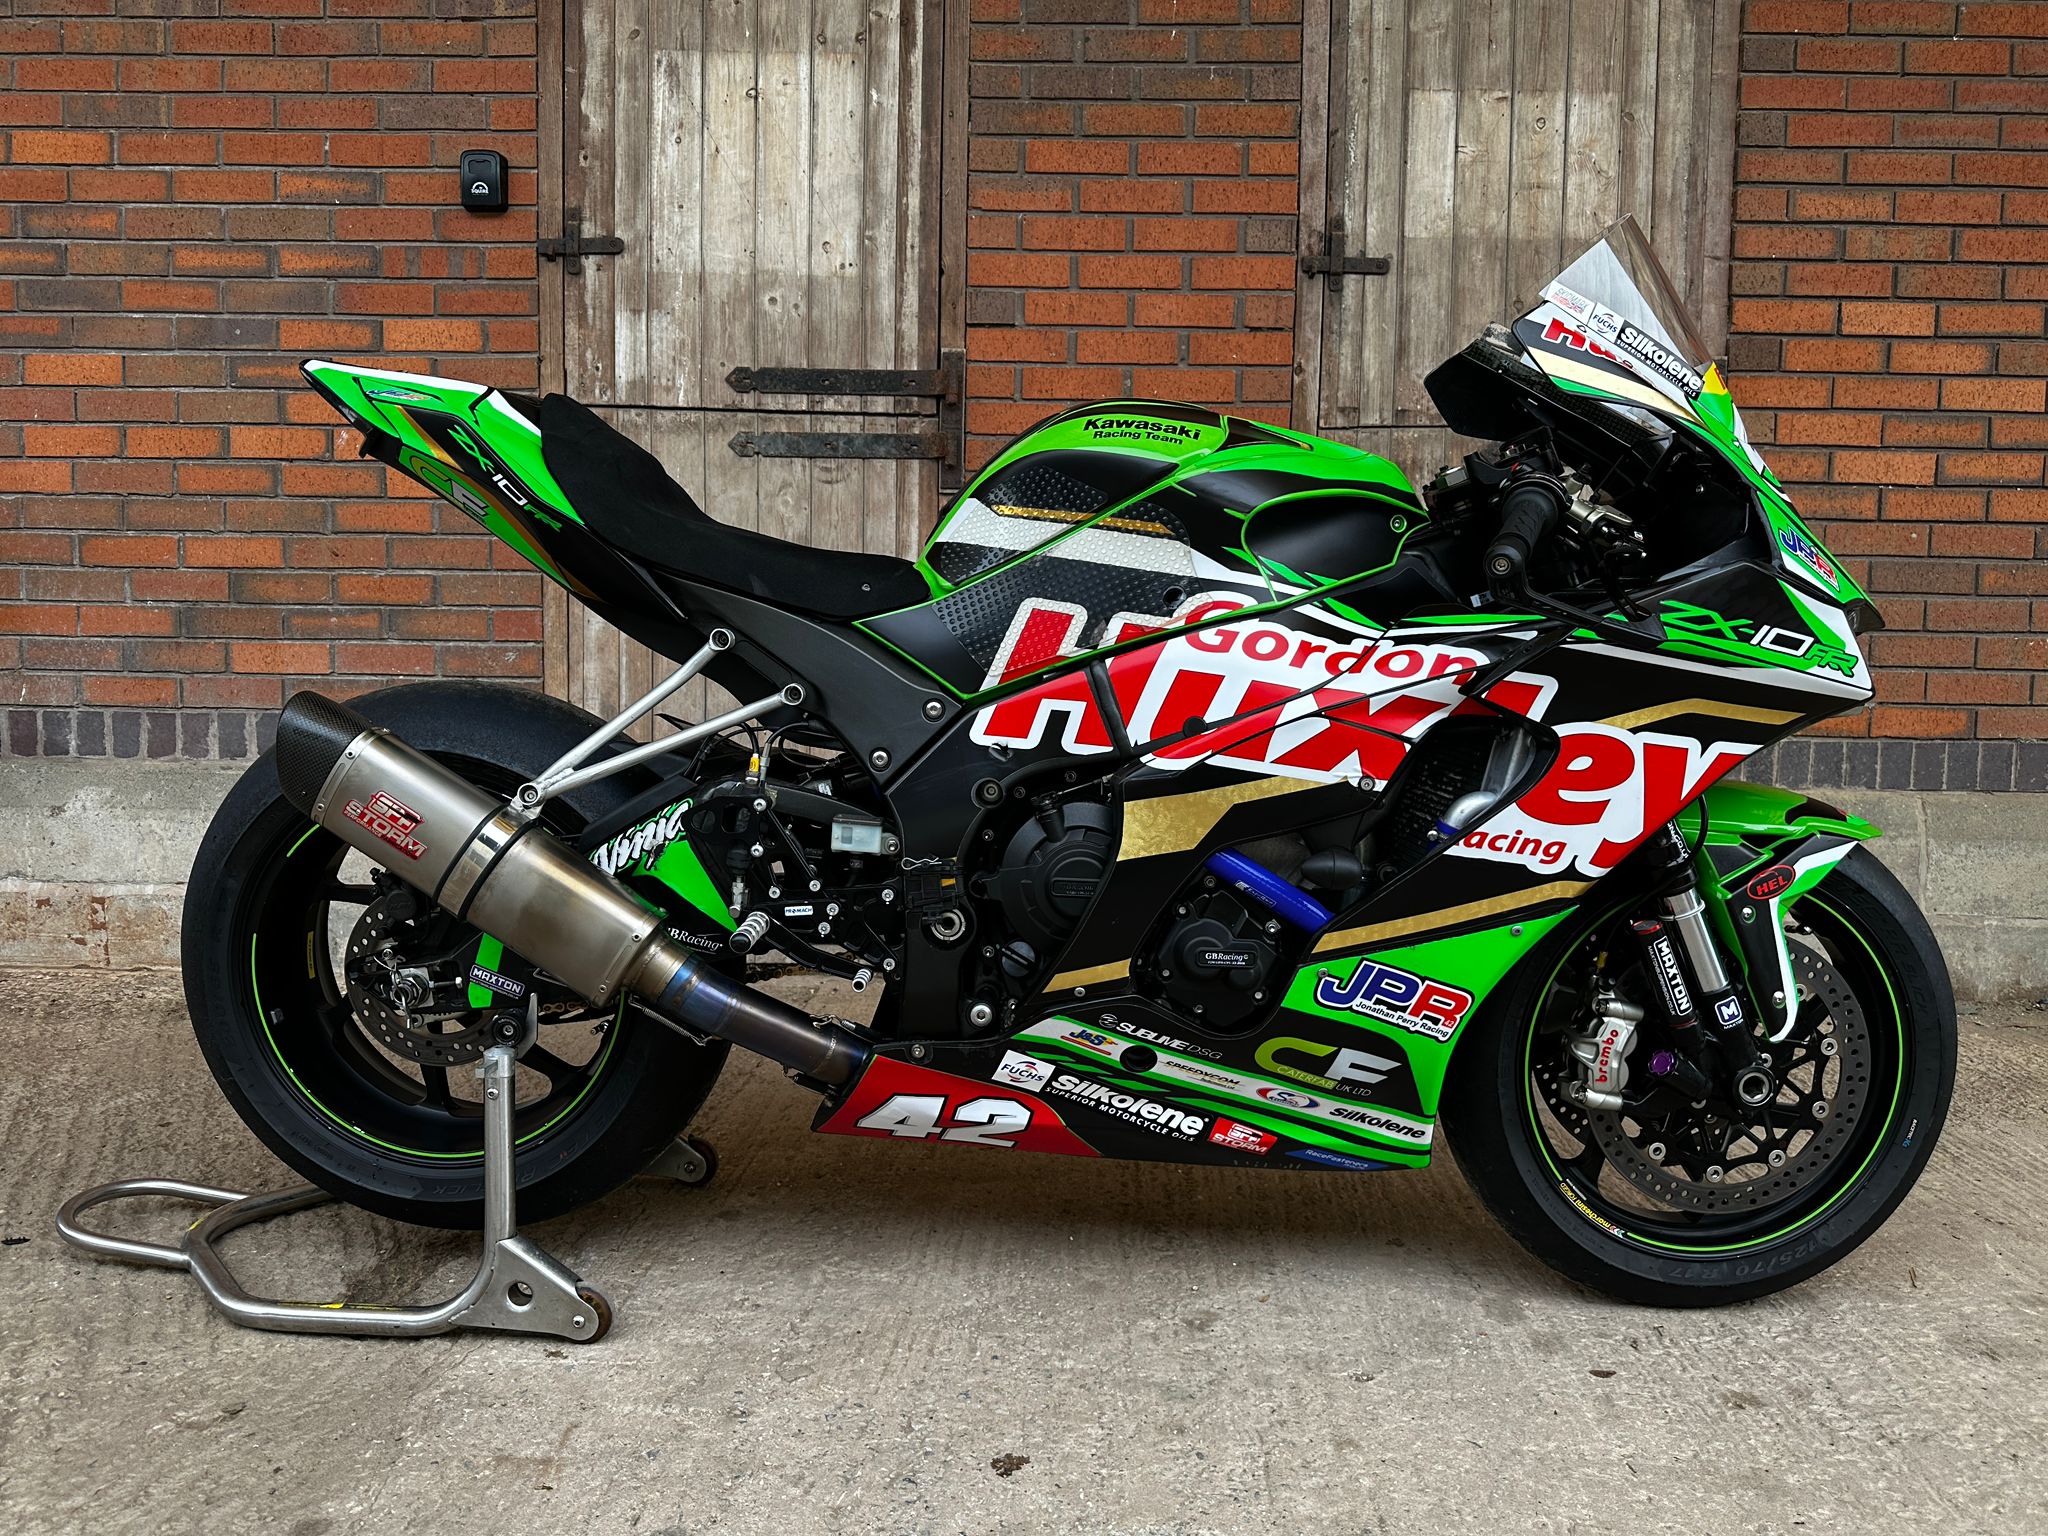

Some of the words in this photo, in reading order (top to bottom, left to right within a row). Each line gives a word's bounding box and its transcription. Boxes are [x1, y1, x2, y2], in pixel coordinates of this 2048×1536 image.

[1593, 314, 1618, 333] FUCHS
[1616, 340, 1646, 360] SUPERIOR
[1647, 358, 1683, 388] MOTORCYCLE
[1683, 386, 1697, 397] OILS
[1620, 327, 1702, 390] Silkolene
[1083, 417, 1202, 442] Kawasaki
[1092, 429, 1142, 441] Racing
[1145, 431, 1184, 445] Team
[1778, 528, 1841, 592] JPR
[1183, 599, 1480, 687] Gordon
[345, 800, 426, 857] STORM
[1457, 829, 1568, 866] acing
[1755, 875, 1788, 896] HEL
[667, 928, 722, 951] BRacing
[1205, 952, 1243, 961] GBRacing
[472, 968, 521, 993] MAXTON
[1657, 939, 1692, 1013] MAXTON
[1318, 961, 1472, 1028] JPR
[1720, 1001, 1740, 1021] M
[1355, 1001, 1395, 1020] Jonathan
[1396, 1014, 1420, 1031] Perry
[1420, 1023, 1449, 1038] Racing
[1443, 1019, 1455, 1027] 42
[1069, 1029, 1108, 1047] J&S
[1116, 1022, 1190, 1050] SUBLIME
[1186, 1044, 1223, 1060] DSG
[1000, 1063, 1046, 1084] FUCHS
[1254, 1036, 1402, 1088] CF
[1595, 1029, 1619, 1083] brembo
[1276, 1064, 1338, 1090] CATERFAB
[1335, 1083, 1353, 1093] UK
[1352, 1087, 1372, 1098] LTD
[855, 1094, 1032, 1148] 42
[1045, 1086, 1096, 1108] SUPERIOR
[1097, 1103, 1169, 1136] MOTORCYCLE
[1171, 1130, 1196, 1142] OILS
[1051, 1074, 1205, 1136] Silkolene
[1329, 1107, 1427, 1139] Silkolene
[1211, 1133, 1268, 1153] STORM
[1576, 1199, 1612, 1228] marchesini
